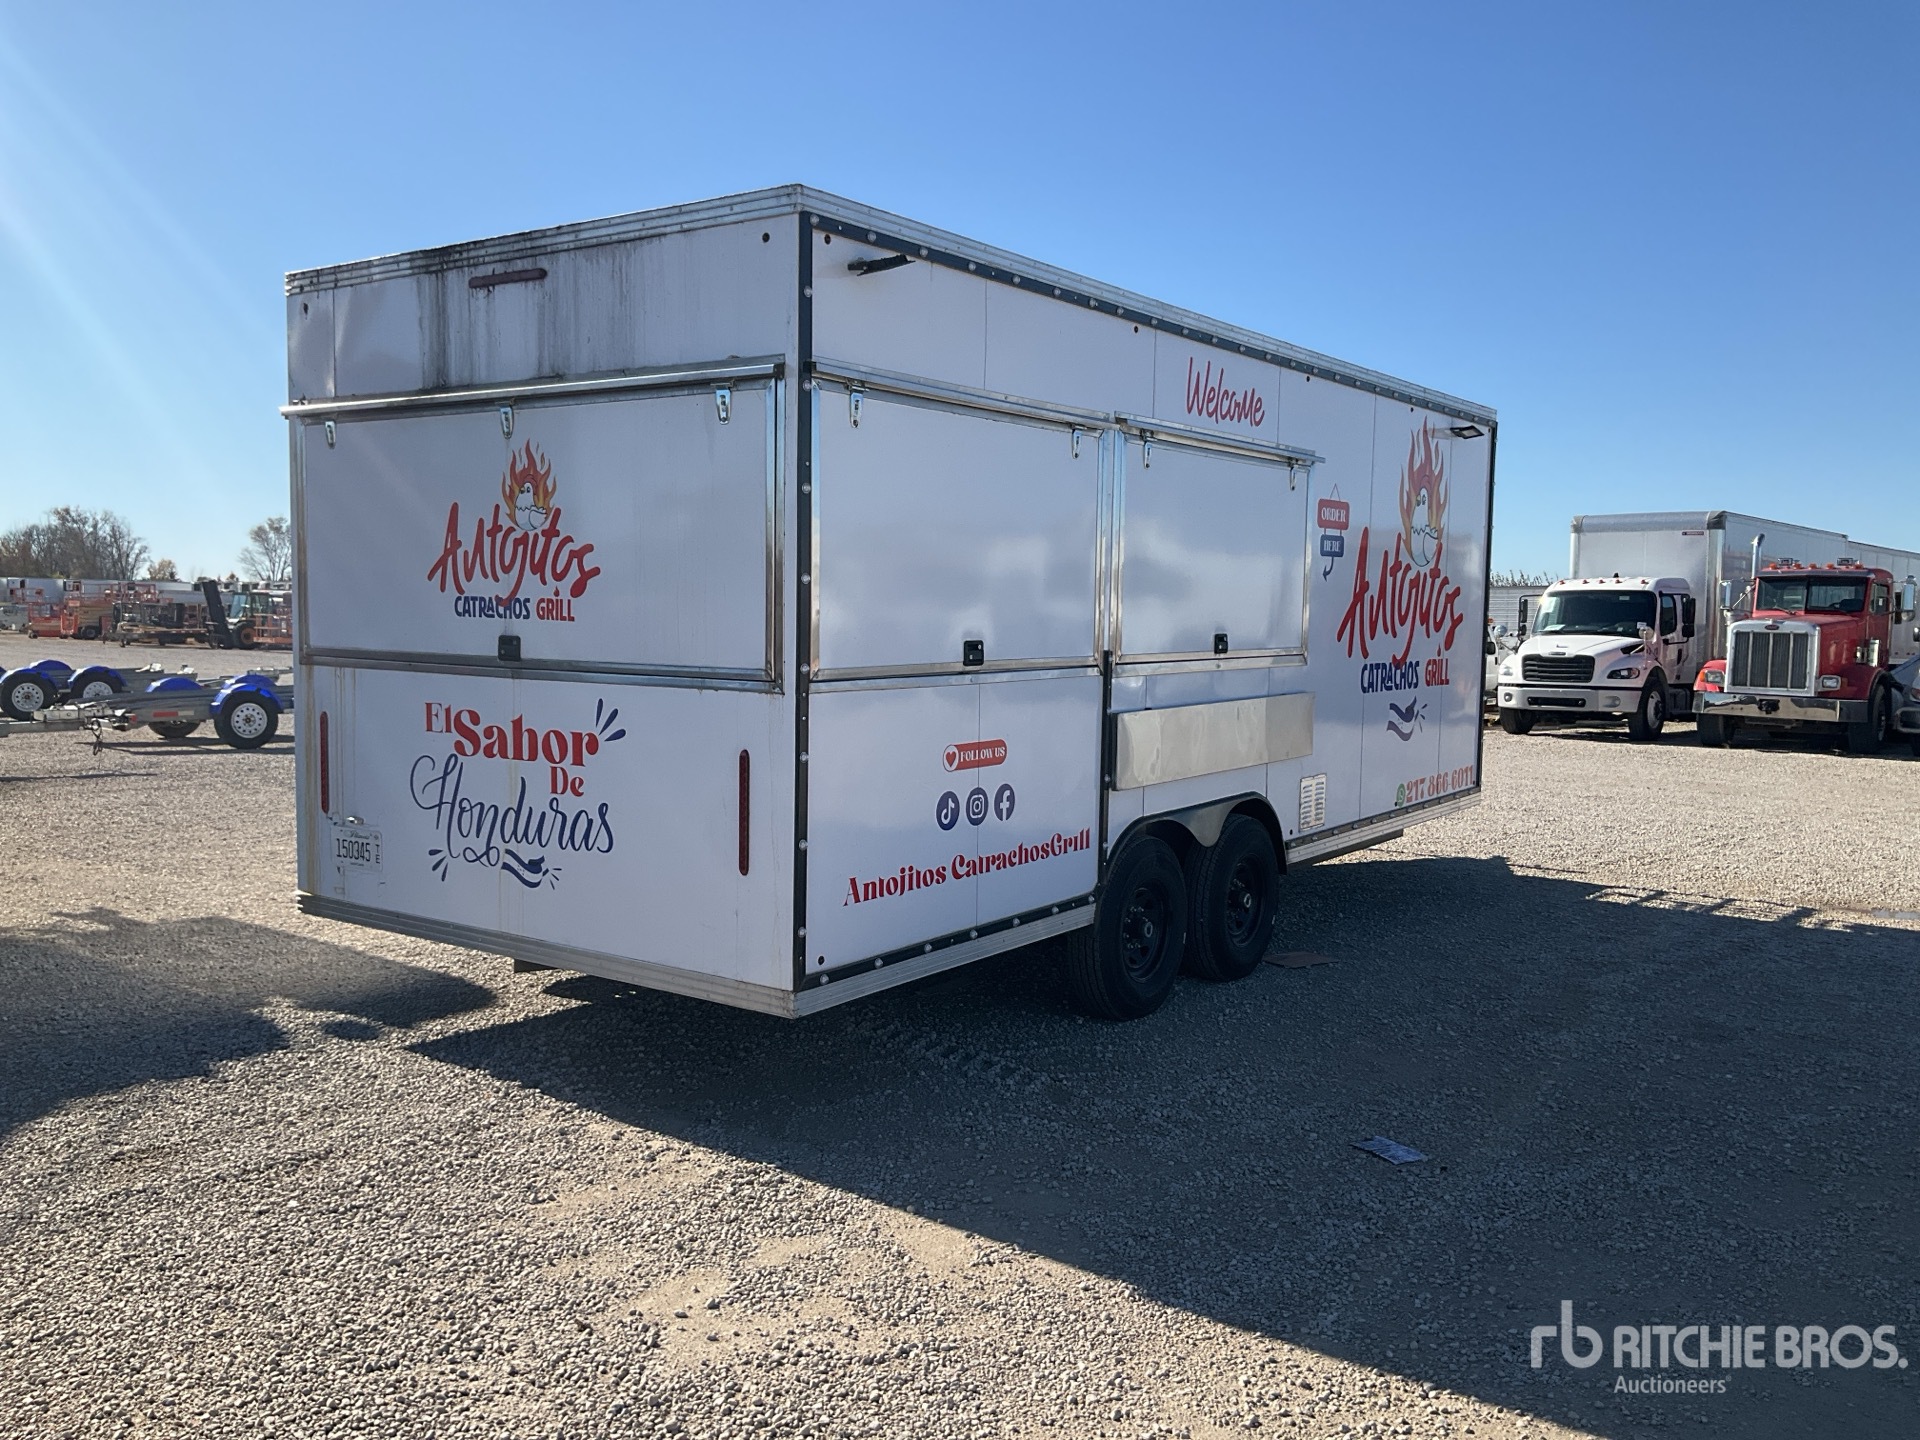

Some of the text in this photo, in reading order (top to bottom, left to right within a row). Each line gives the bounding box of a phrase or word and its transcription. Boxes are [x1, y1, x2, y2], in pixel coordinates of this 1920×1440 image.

[1186, 356, 1265, 427] Welcome
[1321, 507, 1346, 523] ORDER
[1323, 539, 1341, 552] HERE
[454, 587, 575, 622] CATRACHOS GRILL
[1360, 645, 1450, 693] CATRACHOS GRILL
[425, 702, 600, 767] El Sabor
[960, 746, 1006, 762] FOLLOW US
[550, 766, 585, 798] De
[410, 753, 614, 868] Honduras
[336, 838, 371, 862] 150345
[843, 827, 1091, 907] Antojitos CatrachosGrill
